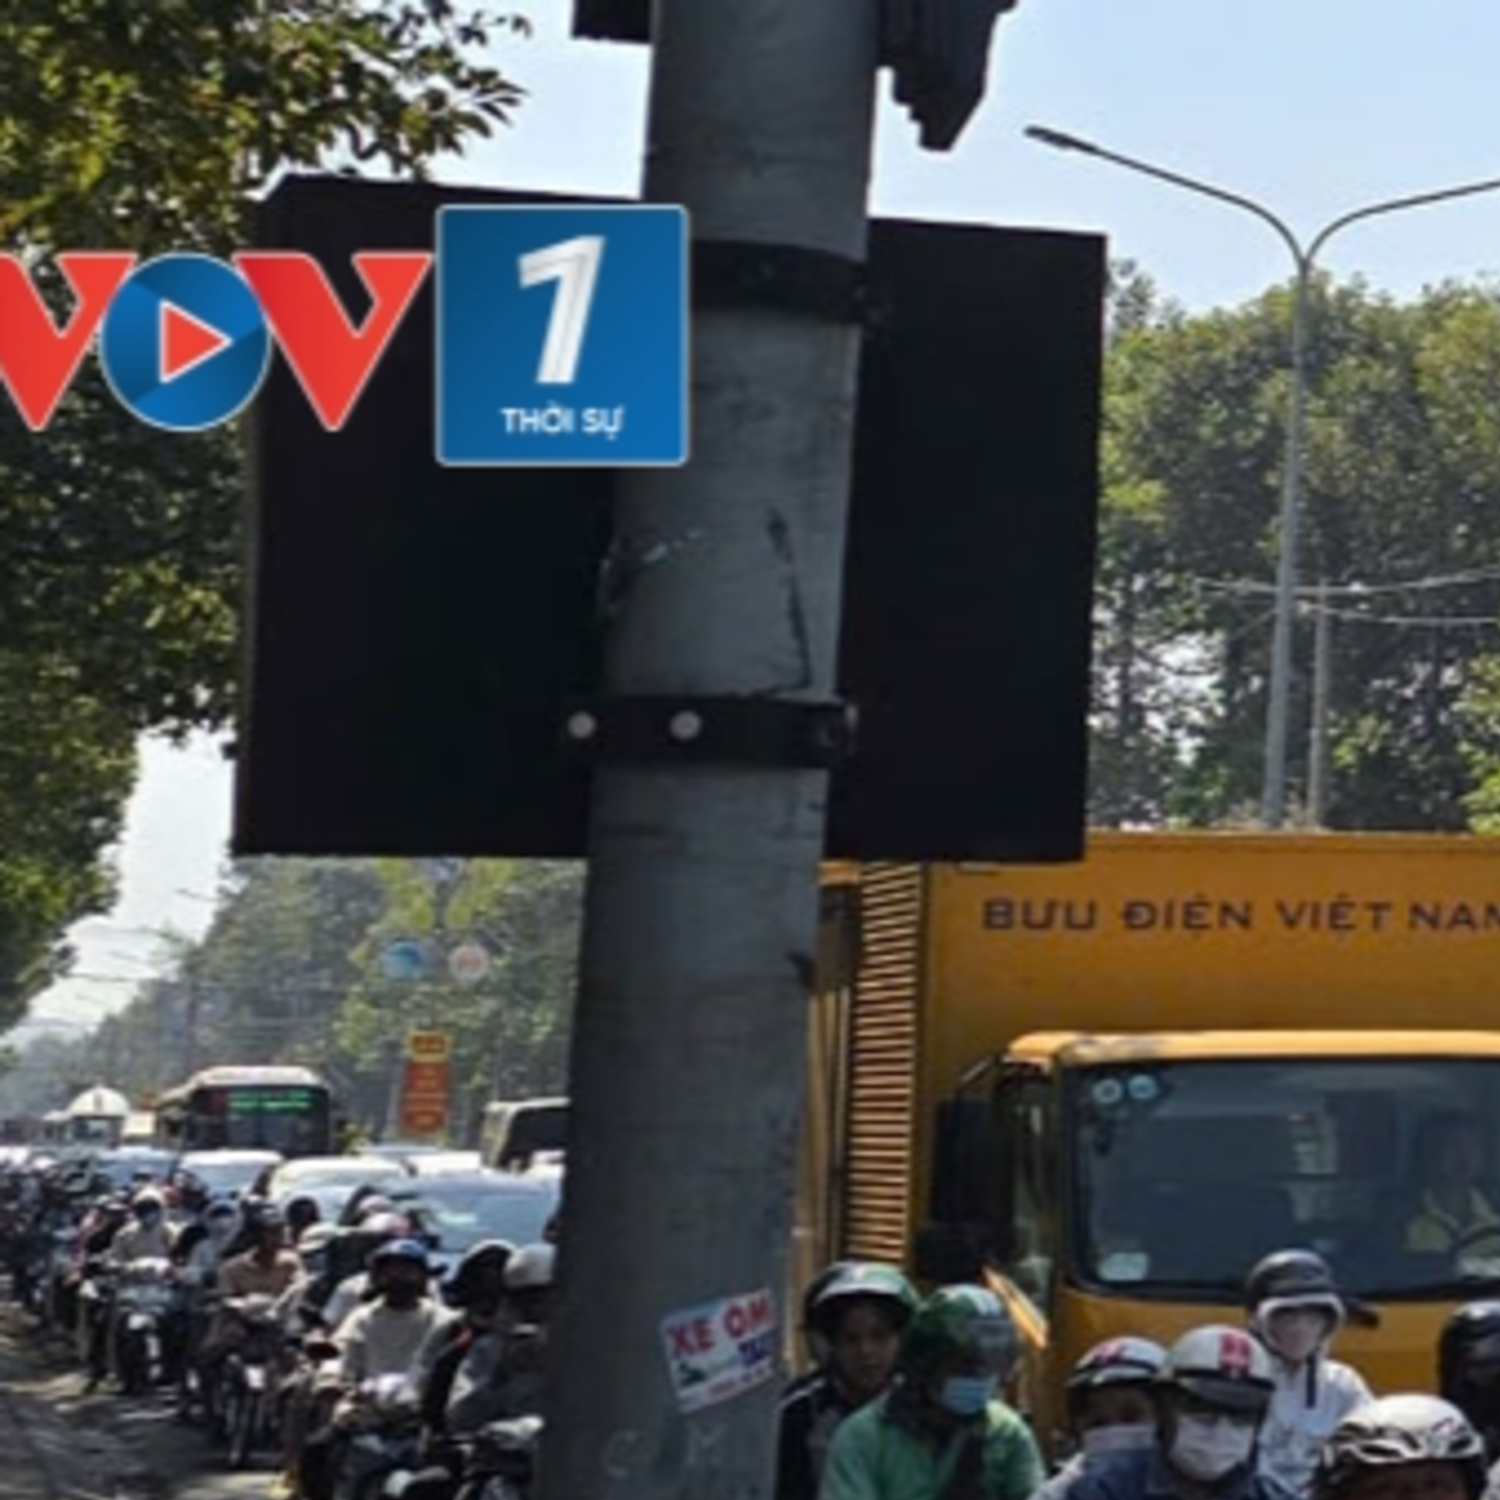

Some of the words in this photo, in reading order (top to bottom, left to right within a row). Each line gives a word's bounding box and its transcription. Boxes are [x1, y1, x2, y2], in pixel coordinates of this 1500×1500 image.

[1121, 893, 1253, 937] ĐIỆN
[1276, 893, 1392, 940] VIỆT
[668, 1317, 714, 1357] XE
